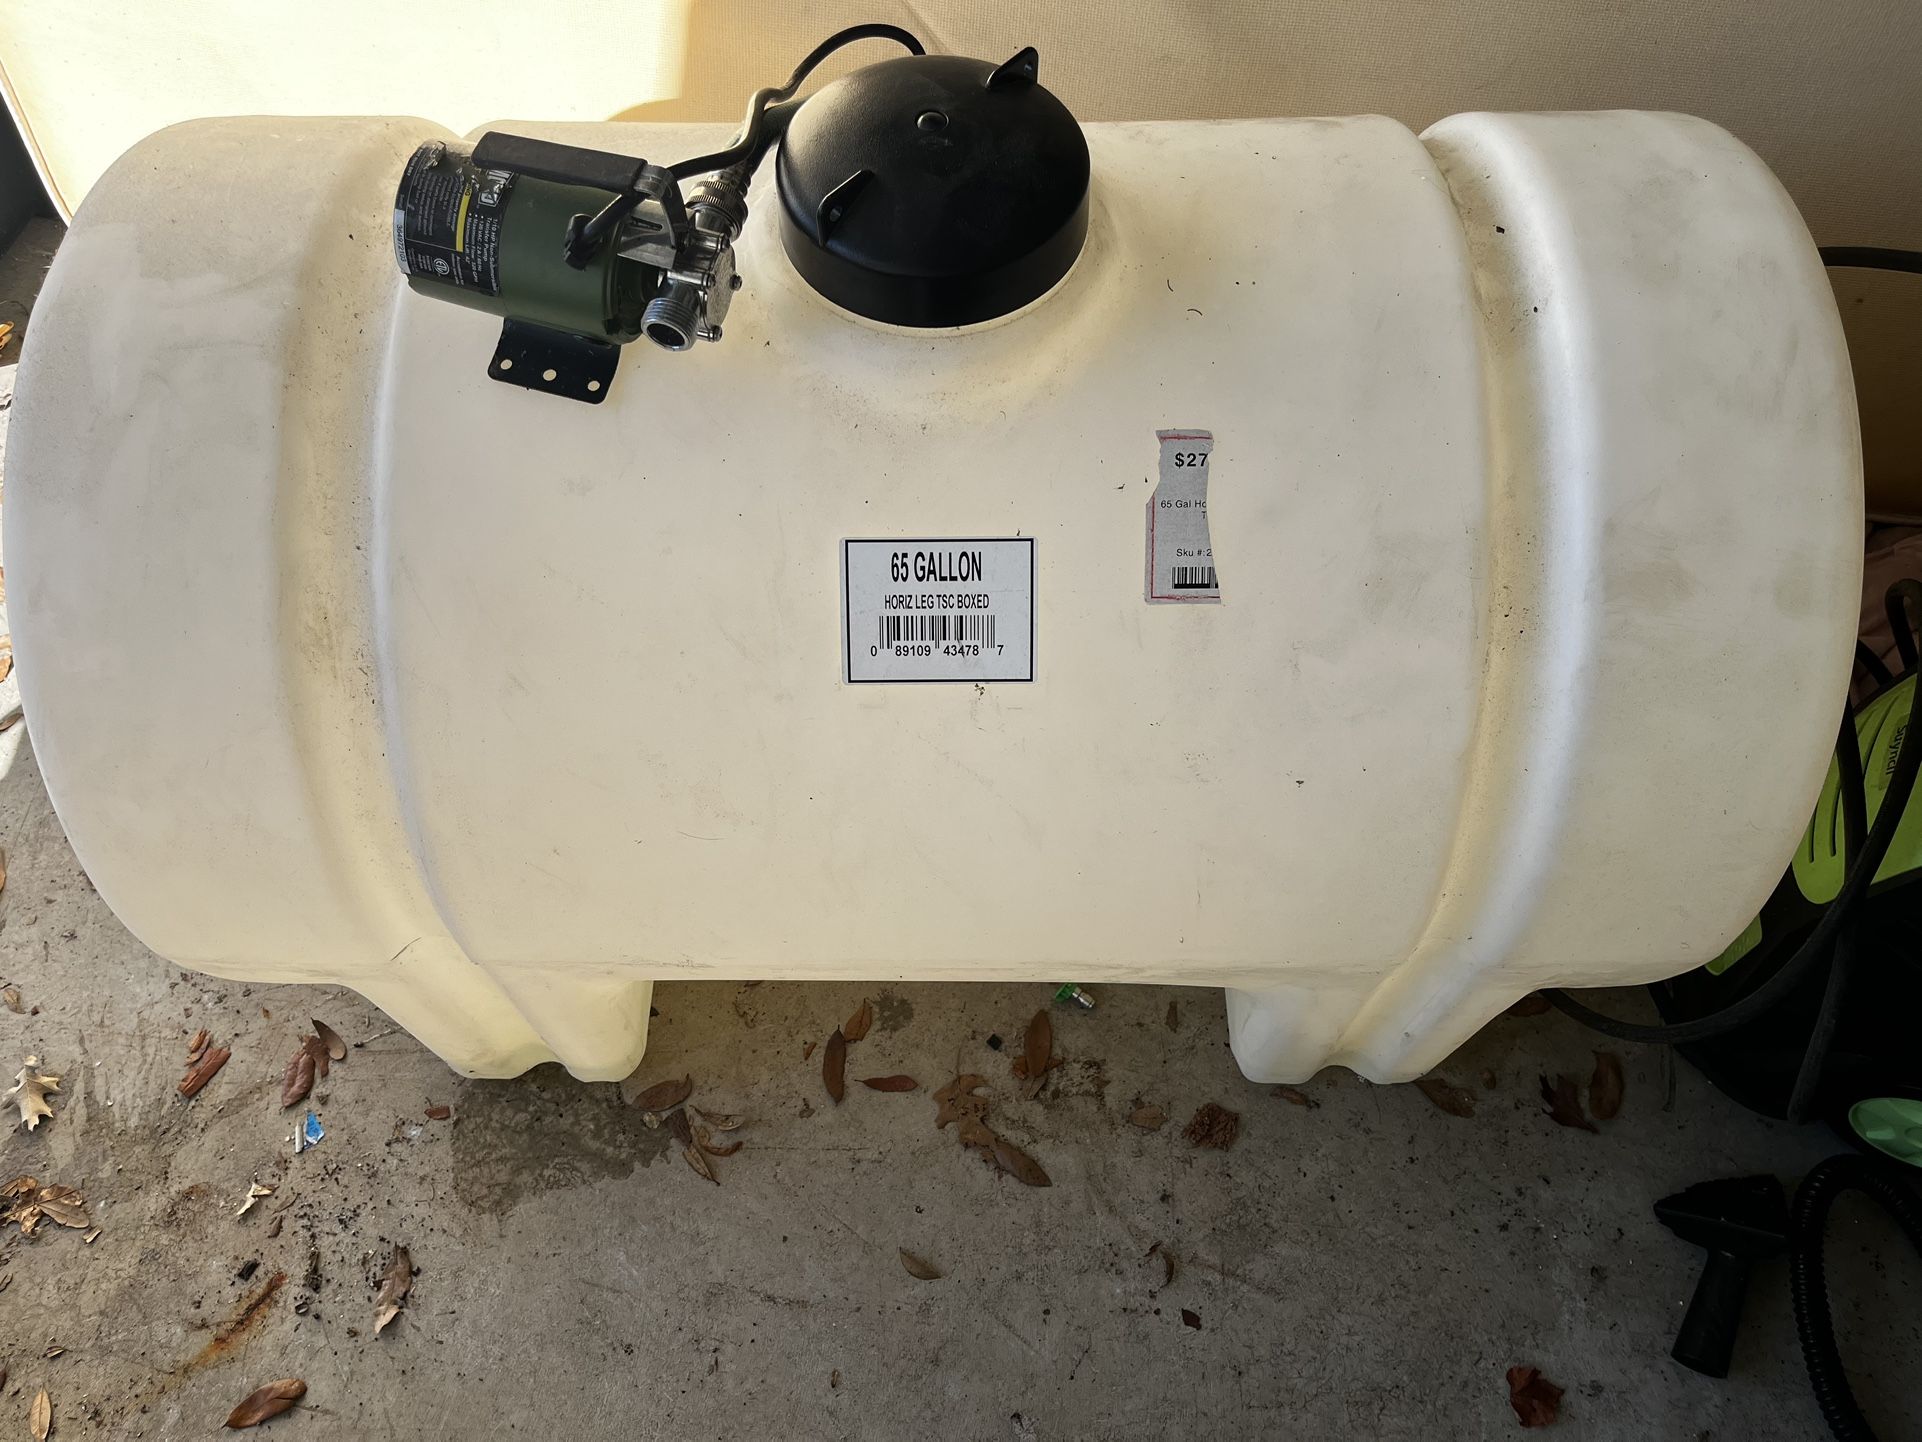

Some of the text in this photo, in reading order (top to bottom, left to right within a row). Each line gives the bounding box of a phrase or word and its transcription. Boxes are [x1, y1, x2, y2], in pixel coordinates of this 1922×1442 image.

[1174, 452, 1208, 468] $27
[1176, 500, 1191, 508] Gal
[891, 551, 982, 582] 65 GALLON
[884, 594, 989, 609] HORIZ LEG TSC BOXED
[870, 645, 1004, 656] 0 89109 43478 7
